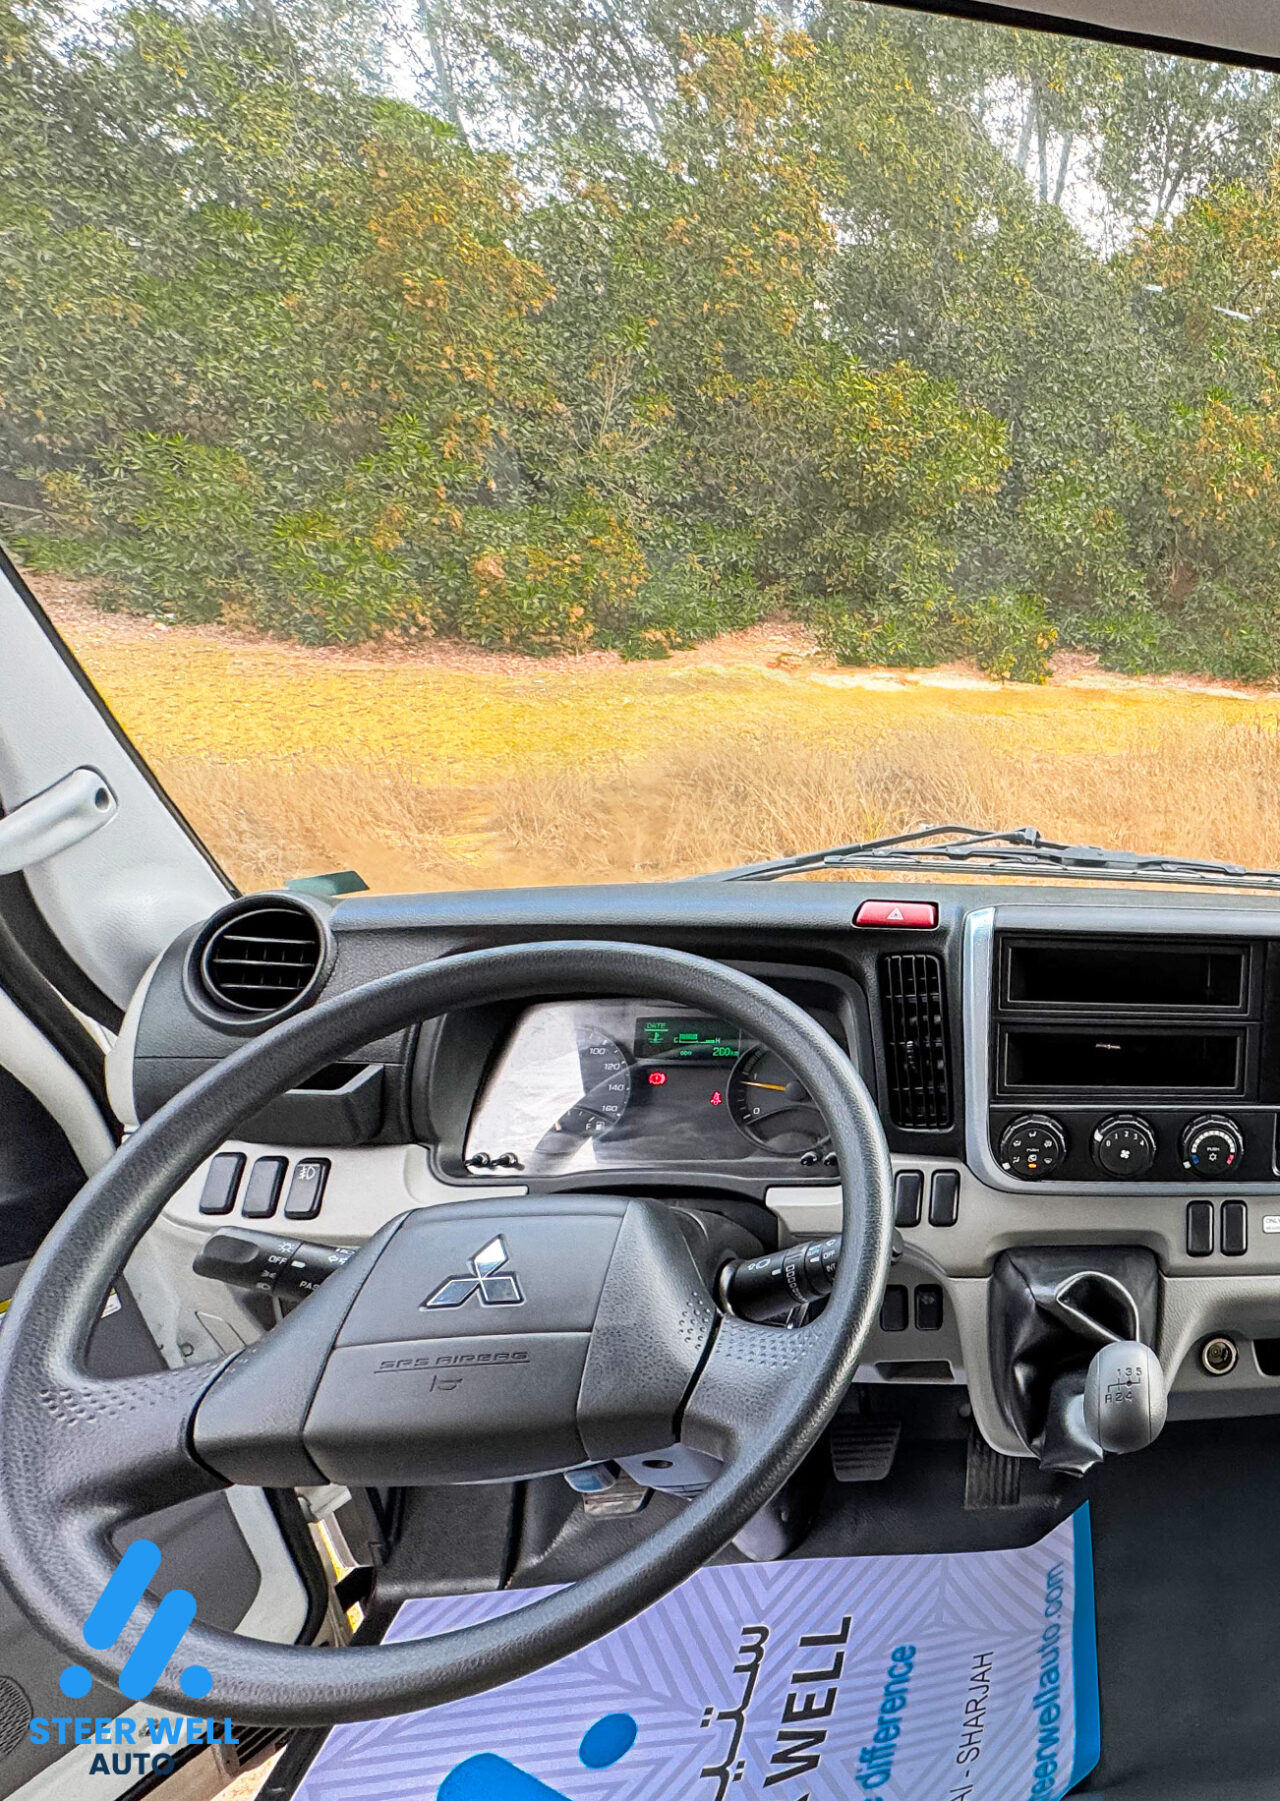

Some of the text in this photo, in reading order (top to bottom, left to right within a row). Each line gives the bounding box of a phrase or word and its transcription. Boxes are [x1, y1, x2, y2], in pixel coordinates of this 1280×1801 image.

[589, 1048, 606, 1056] 100
[604, 1063, 621, 1071] 120
[608, 1084, 625, 1092] 140
[268, 1255, 287, 1265] OFF
[299, 1281, 320, 1291] PAS
[379, 1351, 529, 1370] SRS AIRBAG
[1125, 1367, 1132, 1376] 3
[1135, 1367, 1142, 1376] 5
[1115, 1392, 1123, 1402] 2
[1125, 1391, 1133, 1400] 4
[1029, 1561, 1064, 1801] eerwellauto.com
[763, 1616, 852, 1788] WELL
[956, 1651, 994, 1765] SHARJAH
[855, 1645, 917, 1790] difference
